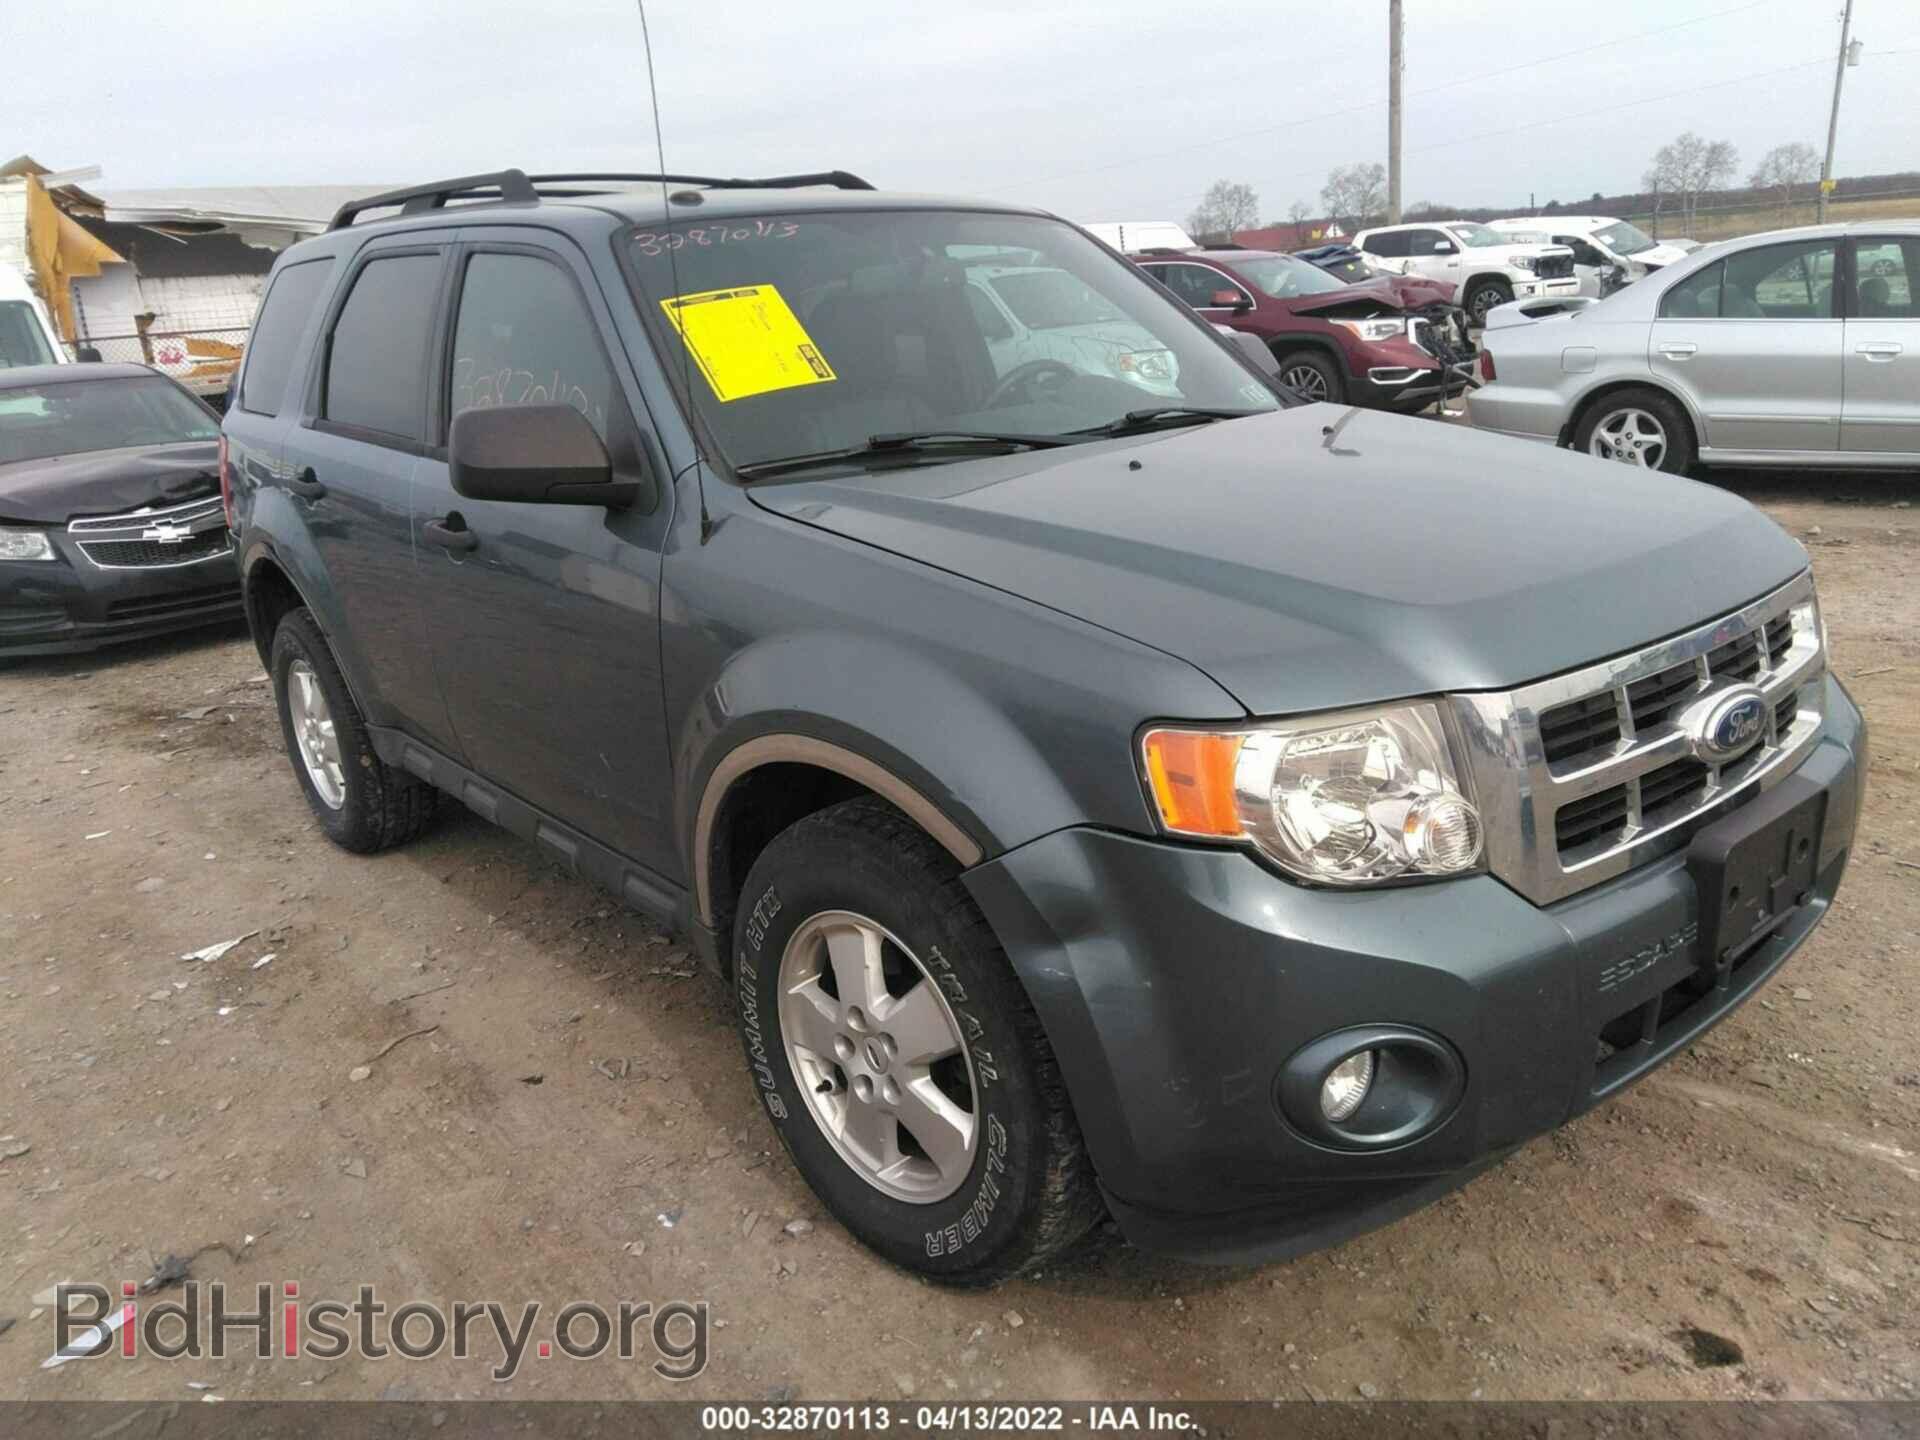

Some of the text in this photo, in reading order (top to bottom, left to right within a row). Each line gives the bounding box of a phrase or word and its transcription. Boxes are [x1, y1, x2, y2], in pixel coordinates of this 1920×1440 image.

[1728, 703, 1761, 744] Ford
[1597, 920, 1698, 993] ESCAPE
[740, 951, 789, 1120] SUMMIT
[924, 945, 1008, 1258] TRAIL CLIMBER
